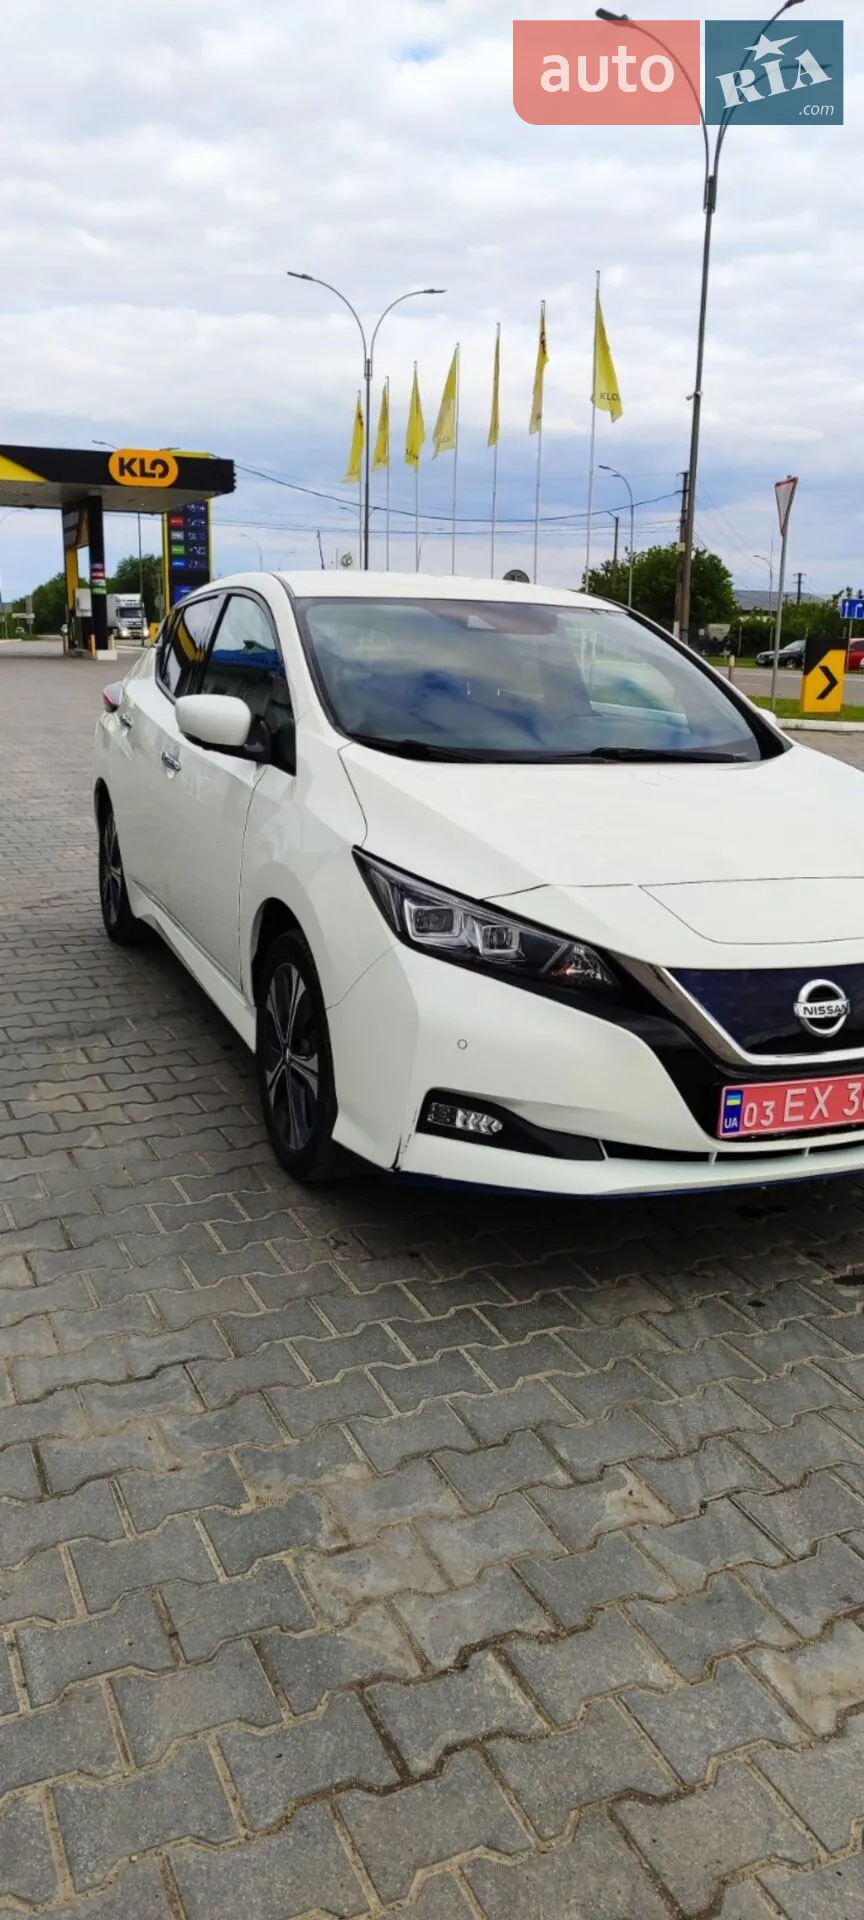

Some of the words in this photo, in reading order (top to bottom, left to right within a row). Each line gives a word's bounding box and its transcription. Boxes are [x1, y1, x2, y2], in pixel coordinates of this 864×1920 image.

[118, 457, 169, 478] KLO
[803, 1002, 848, 1015] NISSAN
[743, 1100, 776, 1127] 03
[783, 1085, 833, 1122] EX
[843, 1083, 864, 1116] 3
[724, 1118, 738, 1129] UA
